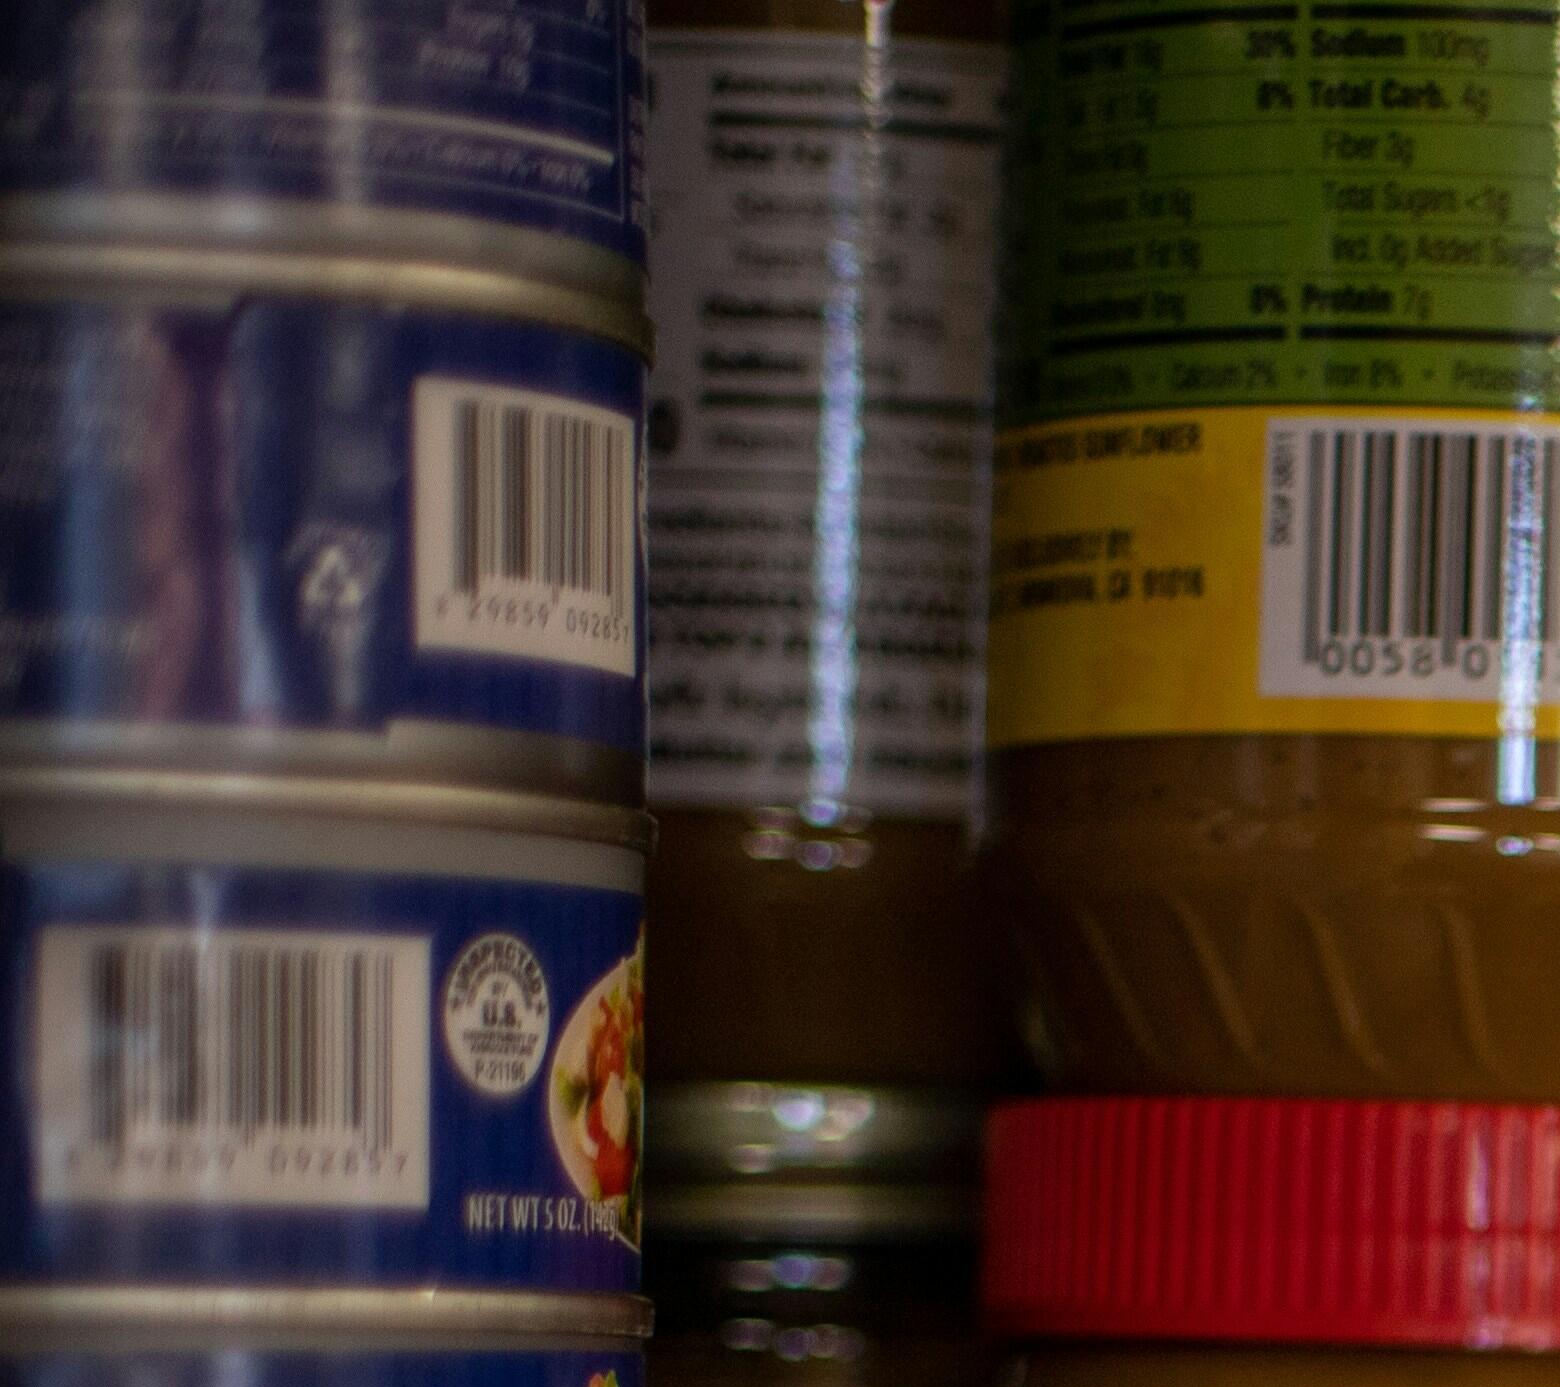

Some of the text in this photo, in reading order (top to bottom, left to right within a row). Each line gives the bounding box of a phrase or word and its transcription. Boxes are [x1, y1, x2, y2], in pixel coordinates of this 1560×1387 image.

[1311, 28, 1405, 58] Sodium
[1307, 79, 1373, 109] Total
[1380, 79, 1451, 109] Carb.
[1322, 129, 1379, 161] Fiber
[1322, 180, 1375, 212] Total
[1414, 233, 1483, 265] Added
[1301, 282, 1394, 313] Protein
[1319, 640, 1434, 678] 0058
[468, 1193, 506, 1233] NET
[511, 1194, 540, 1233] WT
[545, 1197, 554, 1230] 5
[558, 1197, 581, 1231] OZ.
